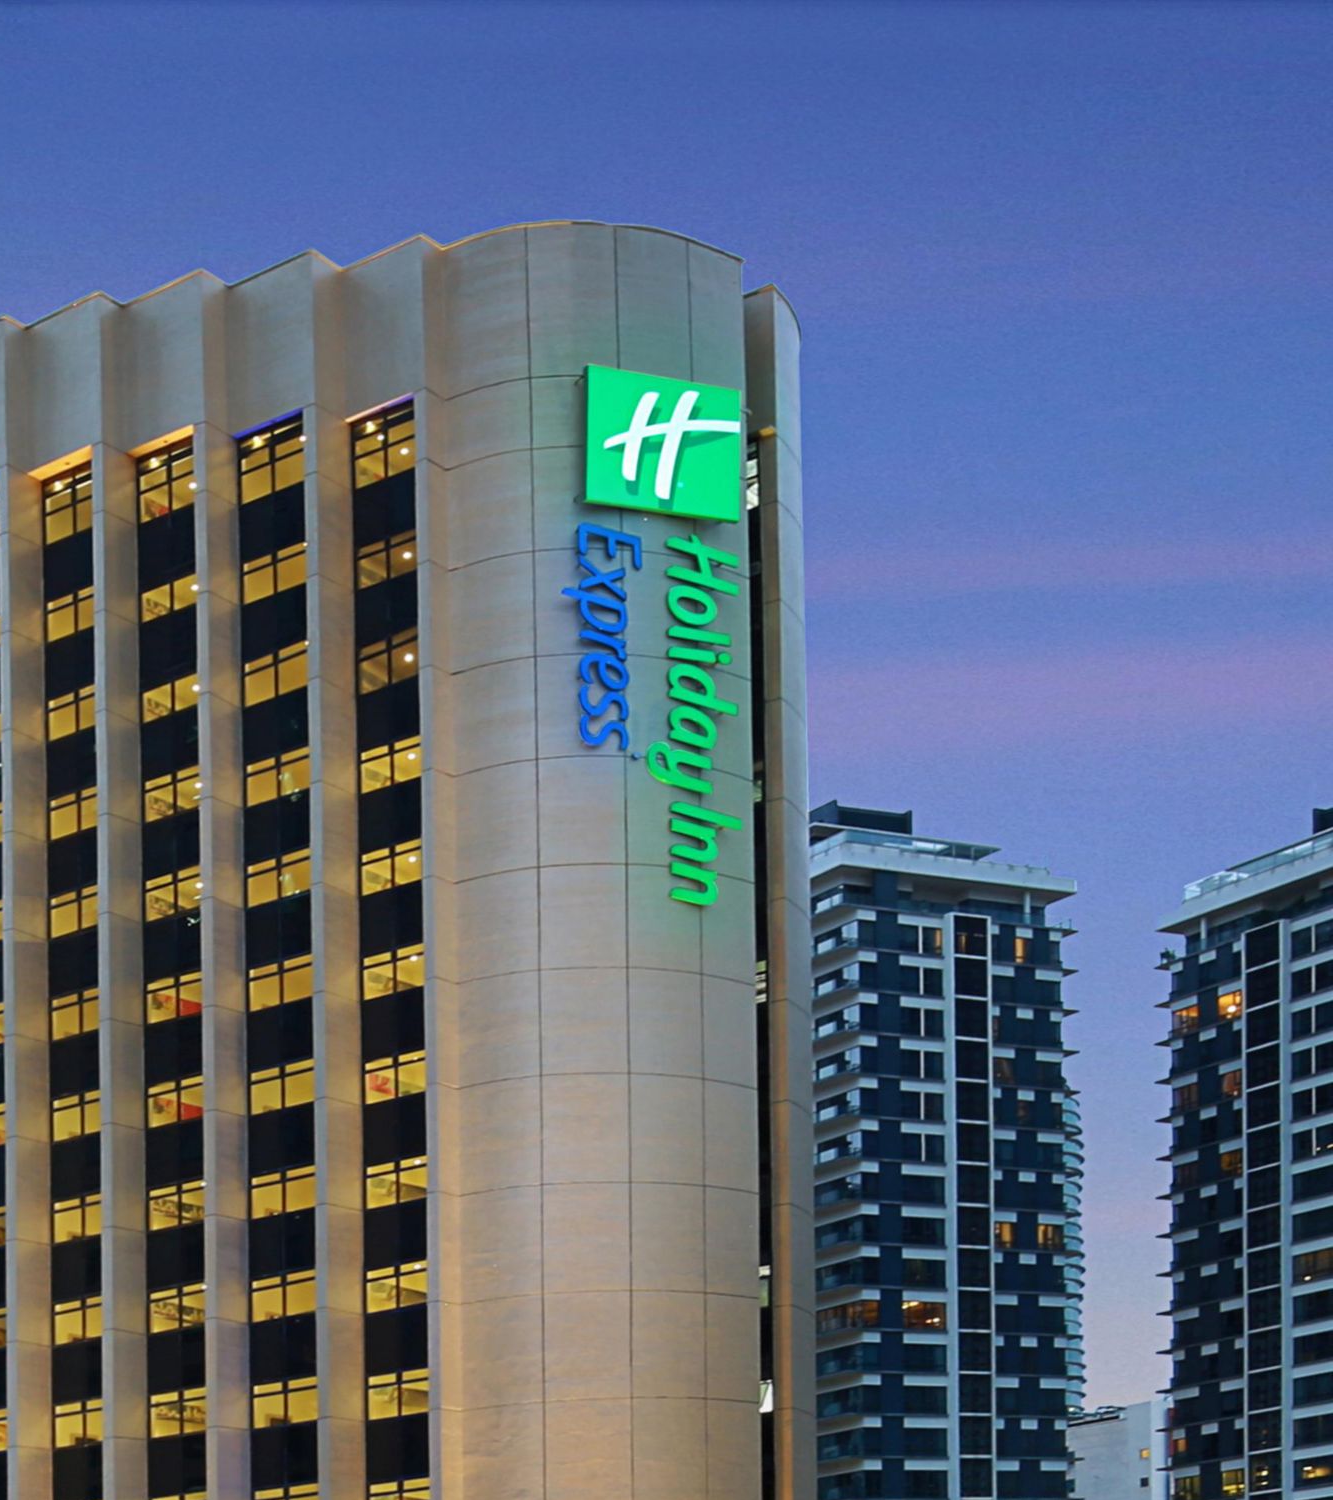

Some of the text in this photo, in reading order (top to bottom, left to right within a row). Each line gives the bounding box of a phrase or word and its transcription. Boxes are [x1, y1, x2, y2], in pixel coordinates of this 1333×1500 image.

[561, 521, 644, 750] Express
[646, 533, 744, 907] Holiday Inn
